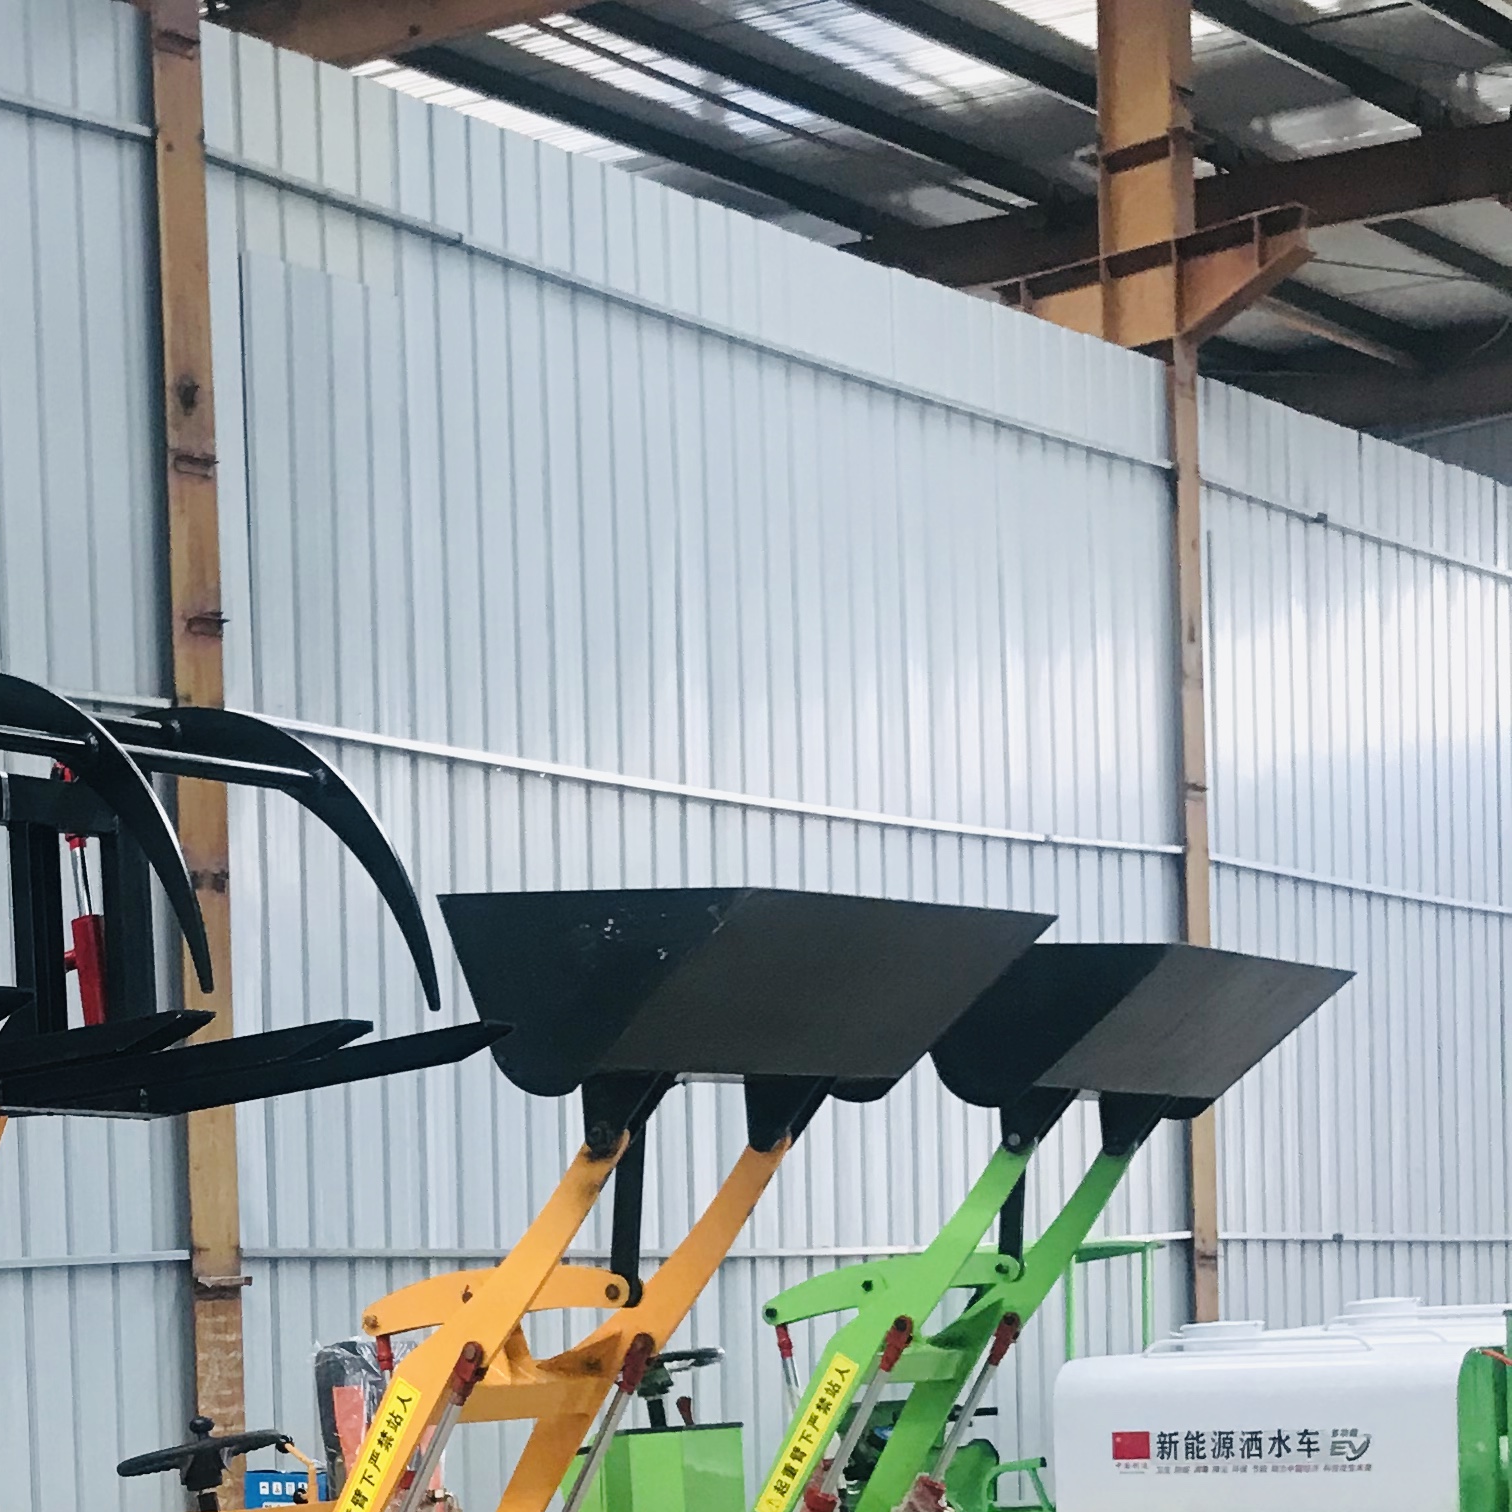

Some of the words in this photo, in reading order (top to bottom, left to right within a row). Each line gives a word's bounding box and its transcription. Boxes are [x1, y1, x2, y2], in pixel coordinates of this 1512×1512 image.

[773, 1366, 851, 1498] 起重臂下严禁站人
[1156, 1428, 1321, 1461] 新能源洒水车
